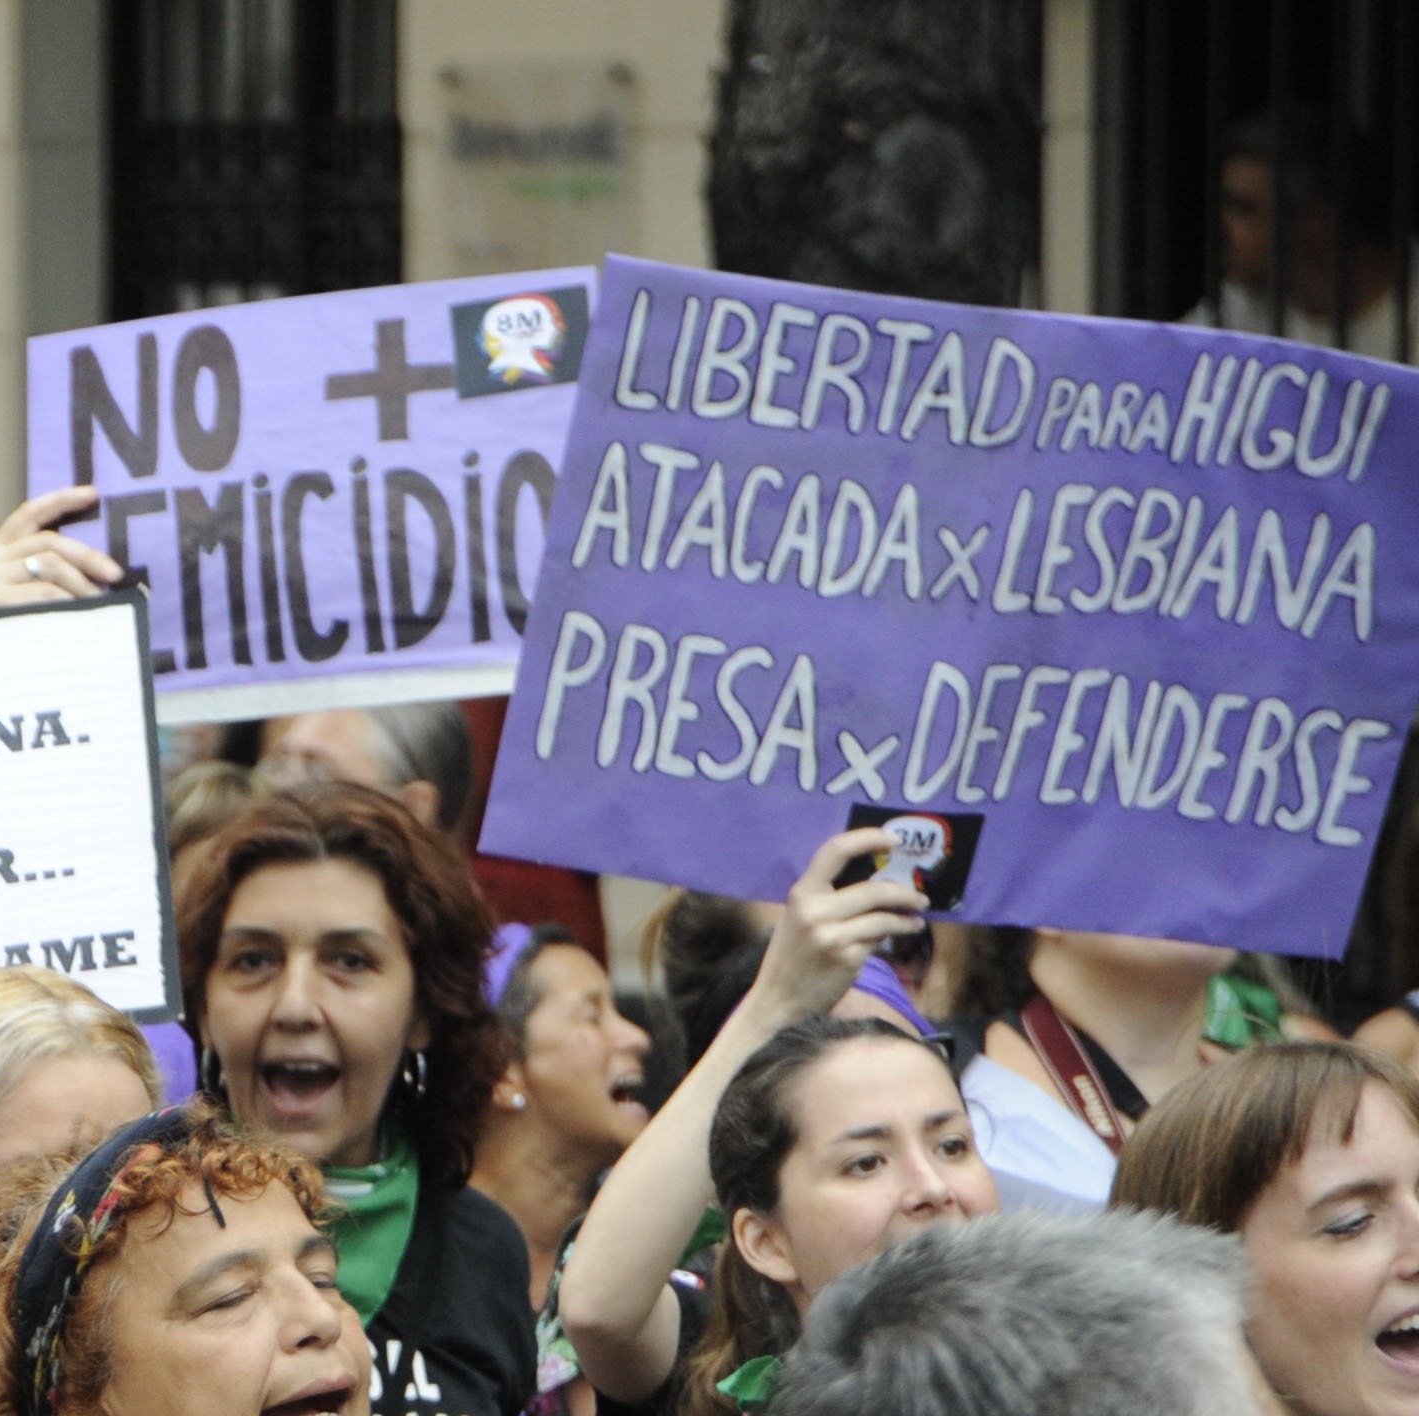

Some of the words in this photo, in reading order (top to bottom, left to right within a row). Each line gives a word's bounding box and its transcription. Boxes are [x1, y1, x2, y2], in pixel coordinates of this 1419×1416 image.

[67, 322, 242, 486] NO
[614, 287, 1037, 449] LIBERTAD
[1035, 375, 1171, 456] PARA
[1169, 350, 1394, 485] HIGUI
[570, 438, 925, 601] ATACADA
[991, 481, 1380, 644] LESBIANA
[534, 608, 820, 795] PRESA
[901, 658, 1395, 851] DEFENDERSE
